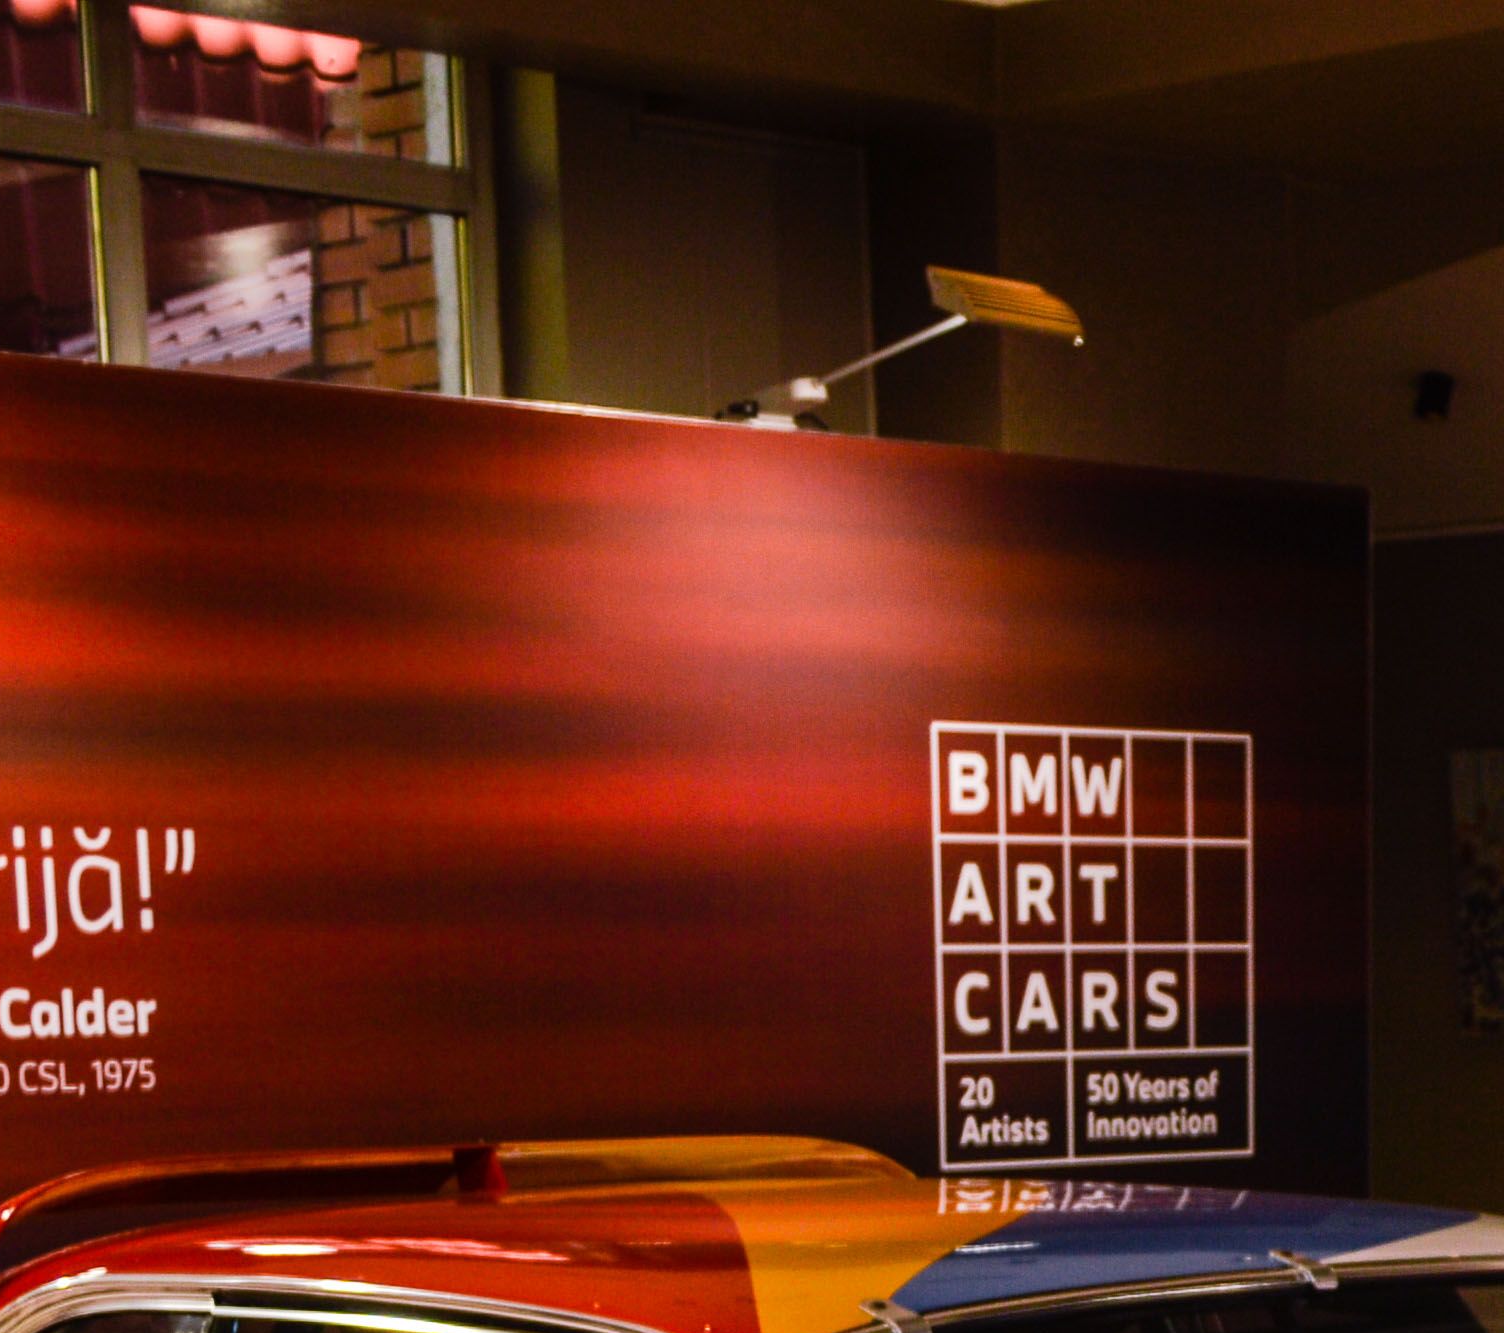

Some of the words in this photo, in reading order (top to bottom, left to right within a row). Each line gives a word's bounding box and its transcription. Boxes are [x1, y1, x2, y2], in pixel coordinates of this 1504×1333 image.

[947, 750, 1124, 816] BMW
[948, 862, 1119, 925] ART
[953, 970, 1181, 1035] CARS
[18, 1061, 87, 1099] CSL,
[92, 1058, 158, 1092] 1975
[959, 1075, 995, 1109] 20
[1086, 1072, 1119, 1104] 50
[1123, 1070, 1189, 1102] Years
[1194, 1068, 1219, 1099] of
[958, 1115, 1049, 1147] Artists
[1087, 1107, 1218, 1141] Innovation
